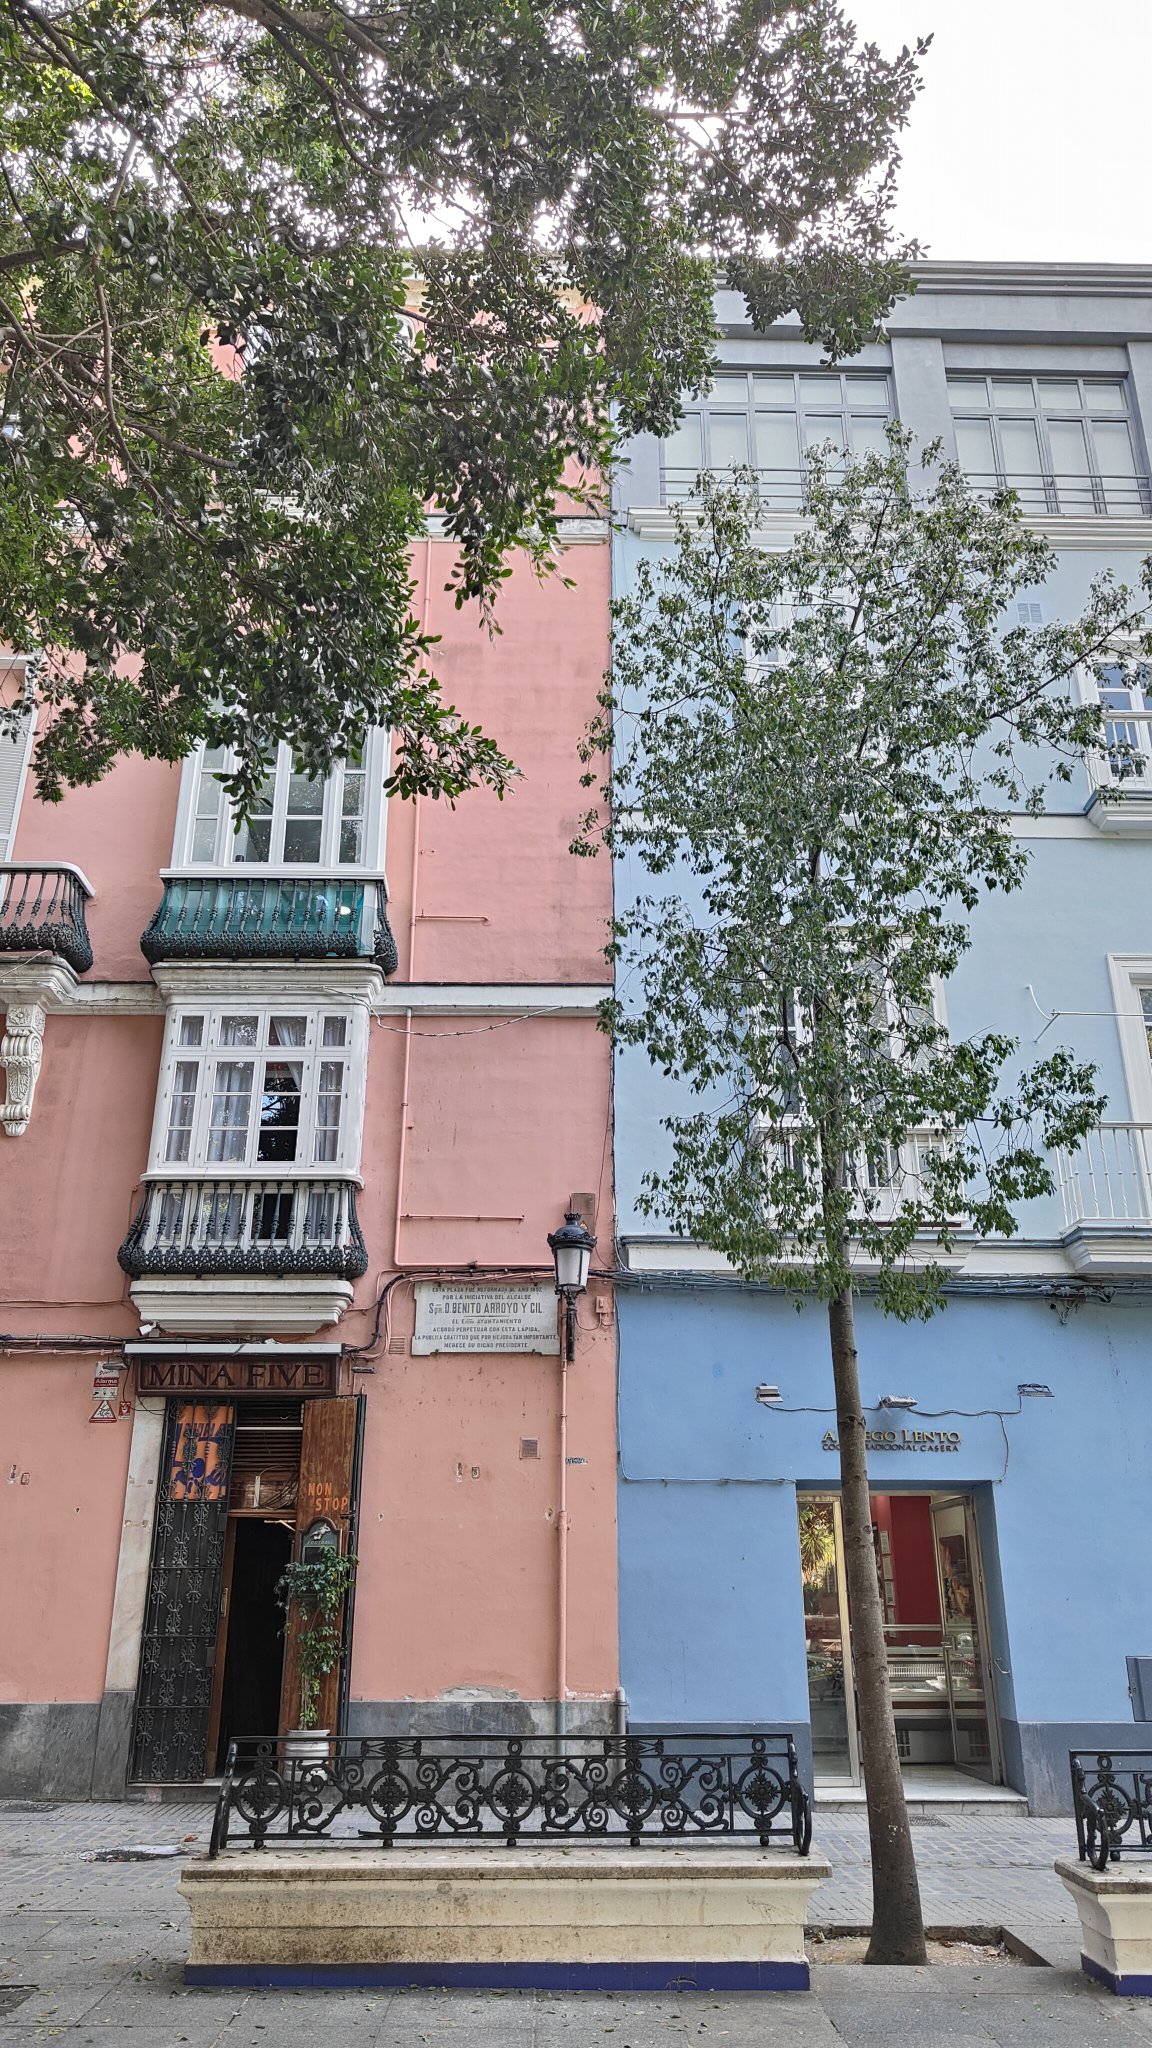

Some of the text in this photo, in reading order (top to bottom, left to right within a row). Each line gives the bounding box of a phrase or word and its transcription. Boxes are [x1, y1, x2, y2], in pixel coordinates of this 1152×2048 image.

[452, 1302, 481, 1314] BENITO
[483, 1302, 518, 1314] ARROYO
[521, 1302, 528, 1314] Y
[149, 1364, 324, 1387] MINA FIVE
[865, 1444, 917, 1452] RADICIONAL
[919, 1445, 959, 1453] CASERA
[307, 1482, 332, 1496] NON
[315, 1496, 349, 1511] STOP
